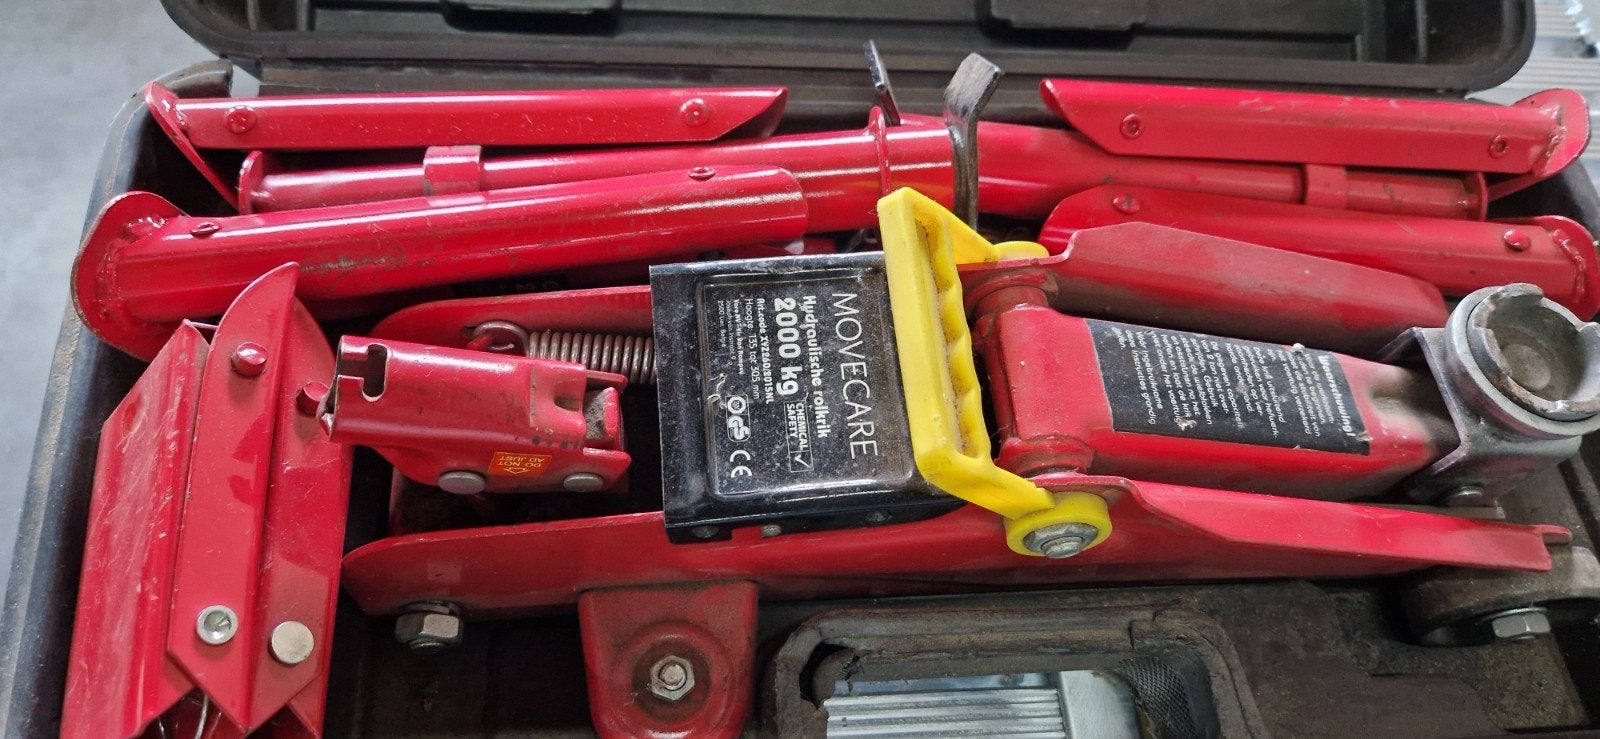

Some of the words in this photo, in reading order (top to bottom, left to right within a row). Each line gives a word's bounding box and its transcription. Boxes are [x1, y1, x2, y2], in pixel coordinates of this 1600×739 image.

[756, 298, 767, 334] Art.code
[774, 297, 801, 358] 2000
[748, 335, 757, 350] 135
[749, 350, 759, 364] tot
[1180, 337, 1194, 362] steeds
[1210, 341, 1218, 350] De
[1214, 353, 1230, 386] gegeven
[1225, 343, 1237, 363] harde
[750, 366, 762, 382] 305
[776, 367, 802, 395] kg
[799, 296, 823, 386] Hydraulische
[813, 391, 830, 438] rolkrik
[832, 293, 878, 459] MOVECARE
[1126, 330, 1136, 347] deze
[1132, 350, 1146, 390] instructies
[1141, 393, 1156, 424] grondig
[1142, 350, 1163, 409] ingebruikname
[1157, 349, 1167, 372] onder
[1163, 374, 1172, 387] het
[1161, 334, 1173, 358] heffen
[1169, 360, 1176, 370] en
[1173, 373, 1182, 388] laat
[1178, 390, 1186, 400] de
[1182, 403, 1191, 417] krik
[1171, 336, 1179, 345] en
[1188, 389, 1195, 399] na
[1192, 401, 1201, 415] het
[1190, 338, 1206, 372] schrijden.
[1204, 375, 1218, 407] Gebruik
[1191, 364, 1198, 374] de
[1201, 340, 1210, 352] van
[1209, 362, 1217, 374] ton
[1214, 377, 1223, 391] niet
[1219, 394, 1229, 413] over-
[1312, 371, 1320, 380] de
[752, 384, 761, 400] mm
[1194, 377, 1212, 425] wielblokken
[1251, 389, 1258, 399] op
[1255, 402, 1263, 416] ver-
[1259, 384, 1268, 401] voor
[1265, 403, 1279, 438] hefwerk-
[1267, 381, 1286, 422] uitsluitend
[1283, 363, 1297, 393] voertuig
[1295, 396, 1311, 434] verzekerd
[1295, 371, 1302, 380] de
[1312, 422, 1320, 436] van
[1318, 355, 1355, 436] Waarschuwing!
[787, 404, 797, 438] SAFETY
[795, 403, 808, 451] CHEMICAL
[730, 450, 752, 478] CE
